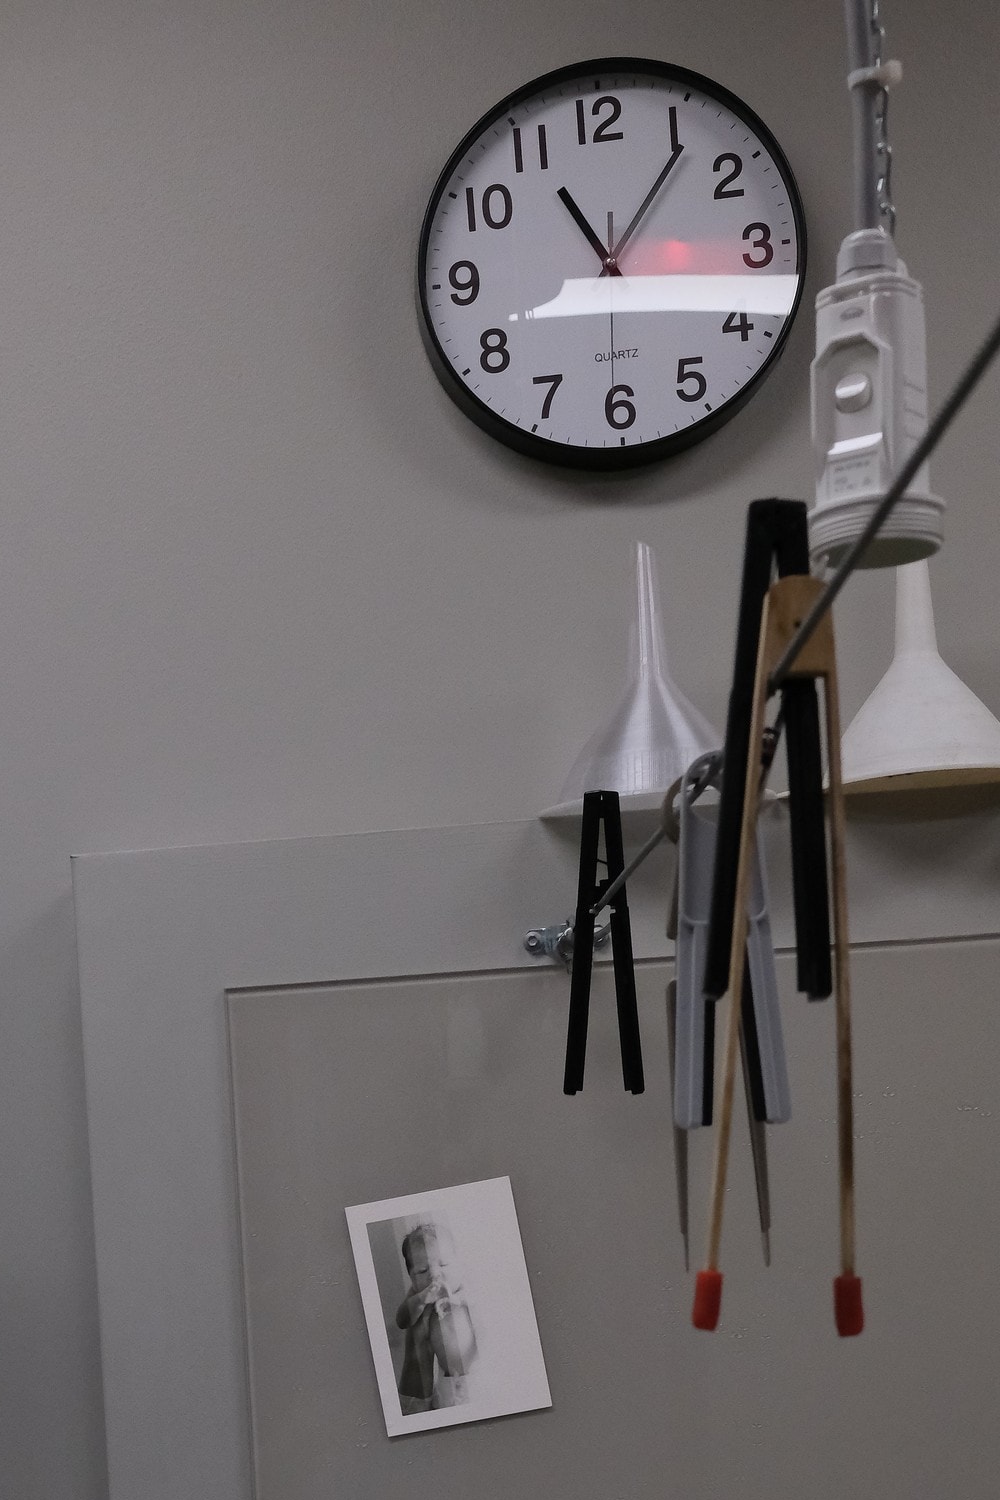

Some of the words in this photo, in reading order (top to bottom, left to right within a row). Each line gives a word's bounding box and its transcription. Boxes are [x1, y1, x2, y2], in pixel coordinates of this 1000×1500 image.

[576, 96, 623, 144] 12
[669, 106, 678, 152] 1
[513, 125, 548, 172] 11
[712, 153, 744, 199] 2
[466, 184, 512, 232] 10
[742, 223, 774, 268] 3
[449, 261, 479, 305] 9
[722, 298, 754, 341] 4
[480, 328, 510, 373] 8
[594, 349, 638, 362] QUARTZ
[533, 374, 563, 419] 7
[676, 356, 706, 402] 5
[605, 385, 636, 429] 6
